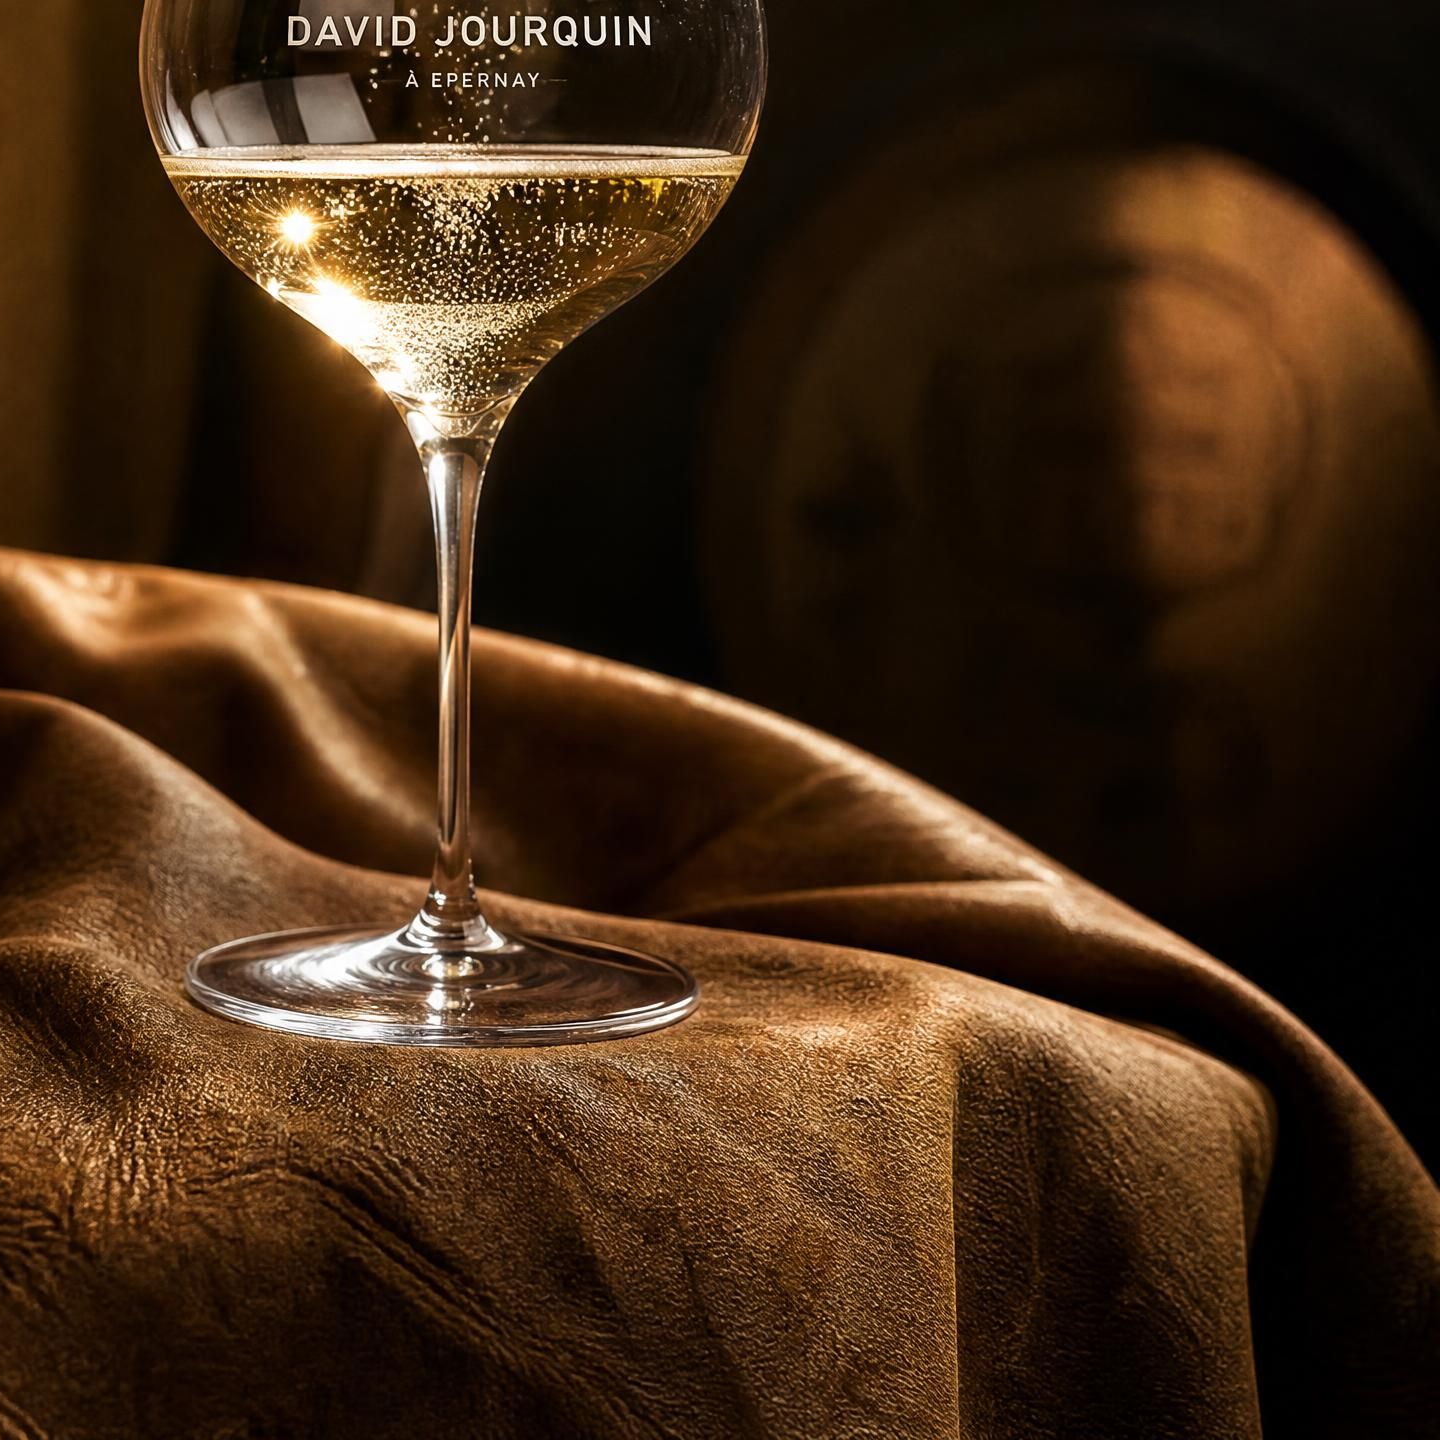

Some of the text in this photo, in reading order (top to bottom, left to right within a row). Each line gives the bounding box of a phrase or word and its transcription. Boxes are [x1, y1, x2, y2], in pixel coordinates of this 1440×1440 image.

[286, 15, 652, 48] DAVID JOURQUIN
[404, 69, 540, 88] À EPERNAY
